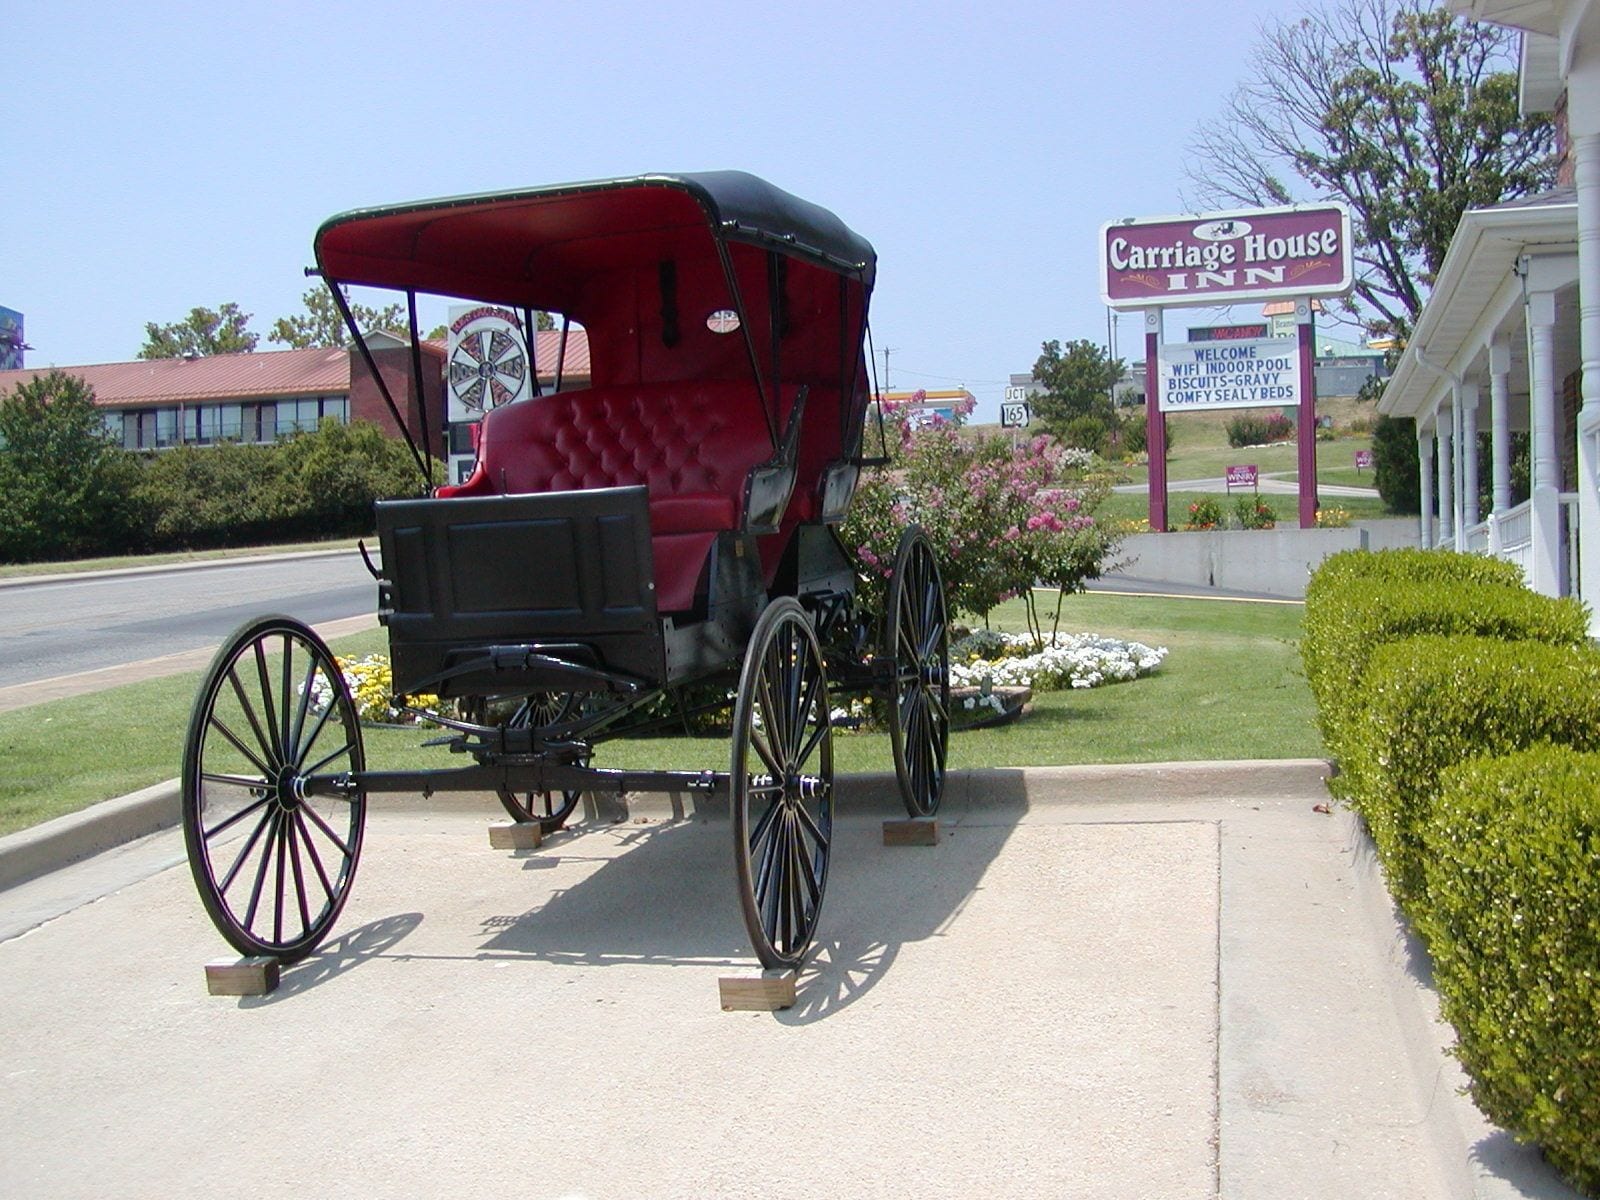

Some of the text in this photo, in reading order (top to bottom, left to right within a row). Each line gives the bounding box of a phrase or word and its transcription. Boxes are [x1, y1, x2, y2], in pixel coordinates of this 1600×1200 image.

[1110, 228, 1337, 271] Carriage House
[1167, 266, 1286, 291] INN
[1195, 346, 1257, 361] WELCOME
[1172, 358, 1292, 376] WIFI INDOOR POOL
[1169, 372, 1280, 390] BISCUITS-GRAVY
[1007, 388, 1024, 400] JCT
[1167, 385, 1293, 403] COMFY SEALY BEDS
[1006, 407, 1023, 421] 165
